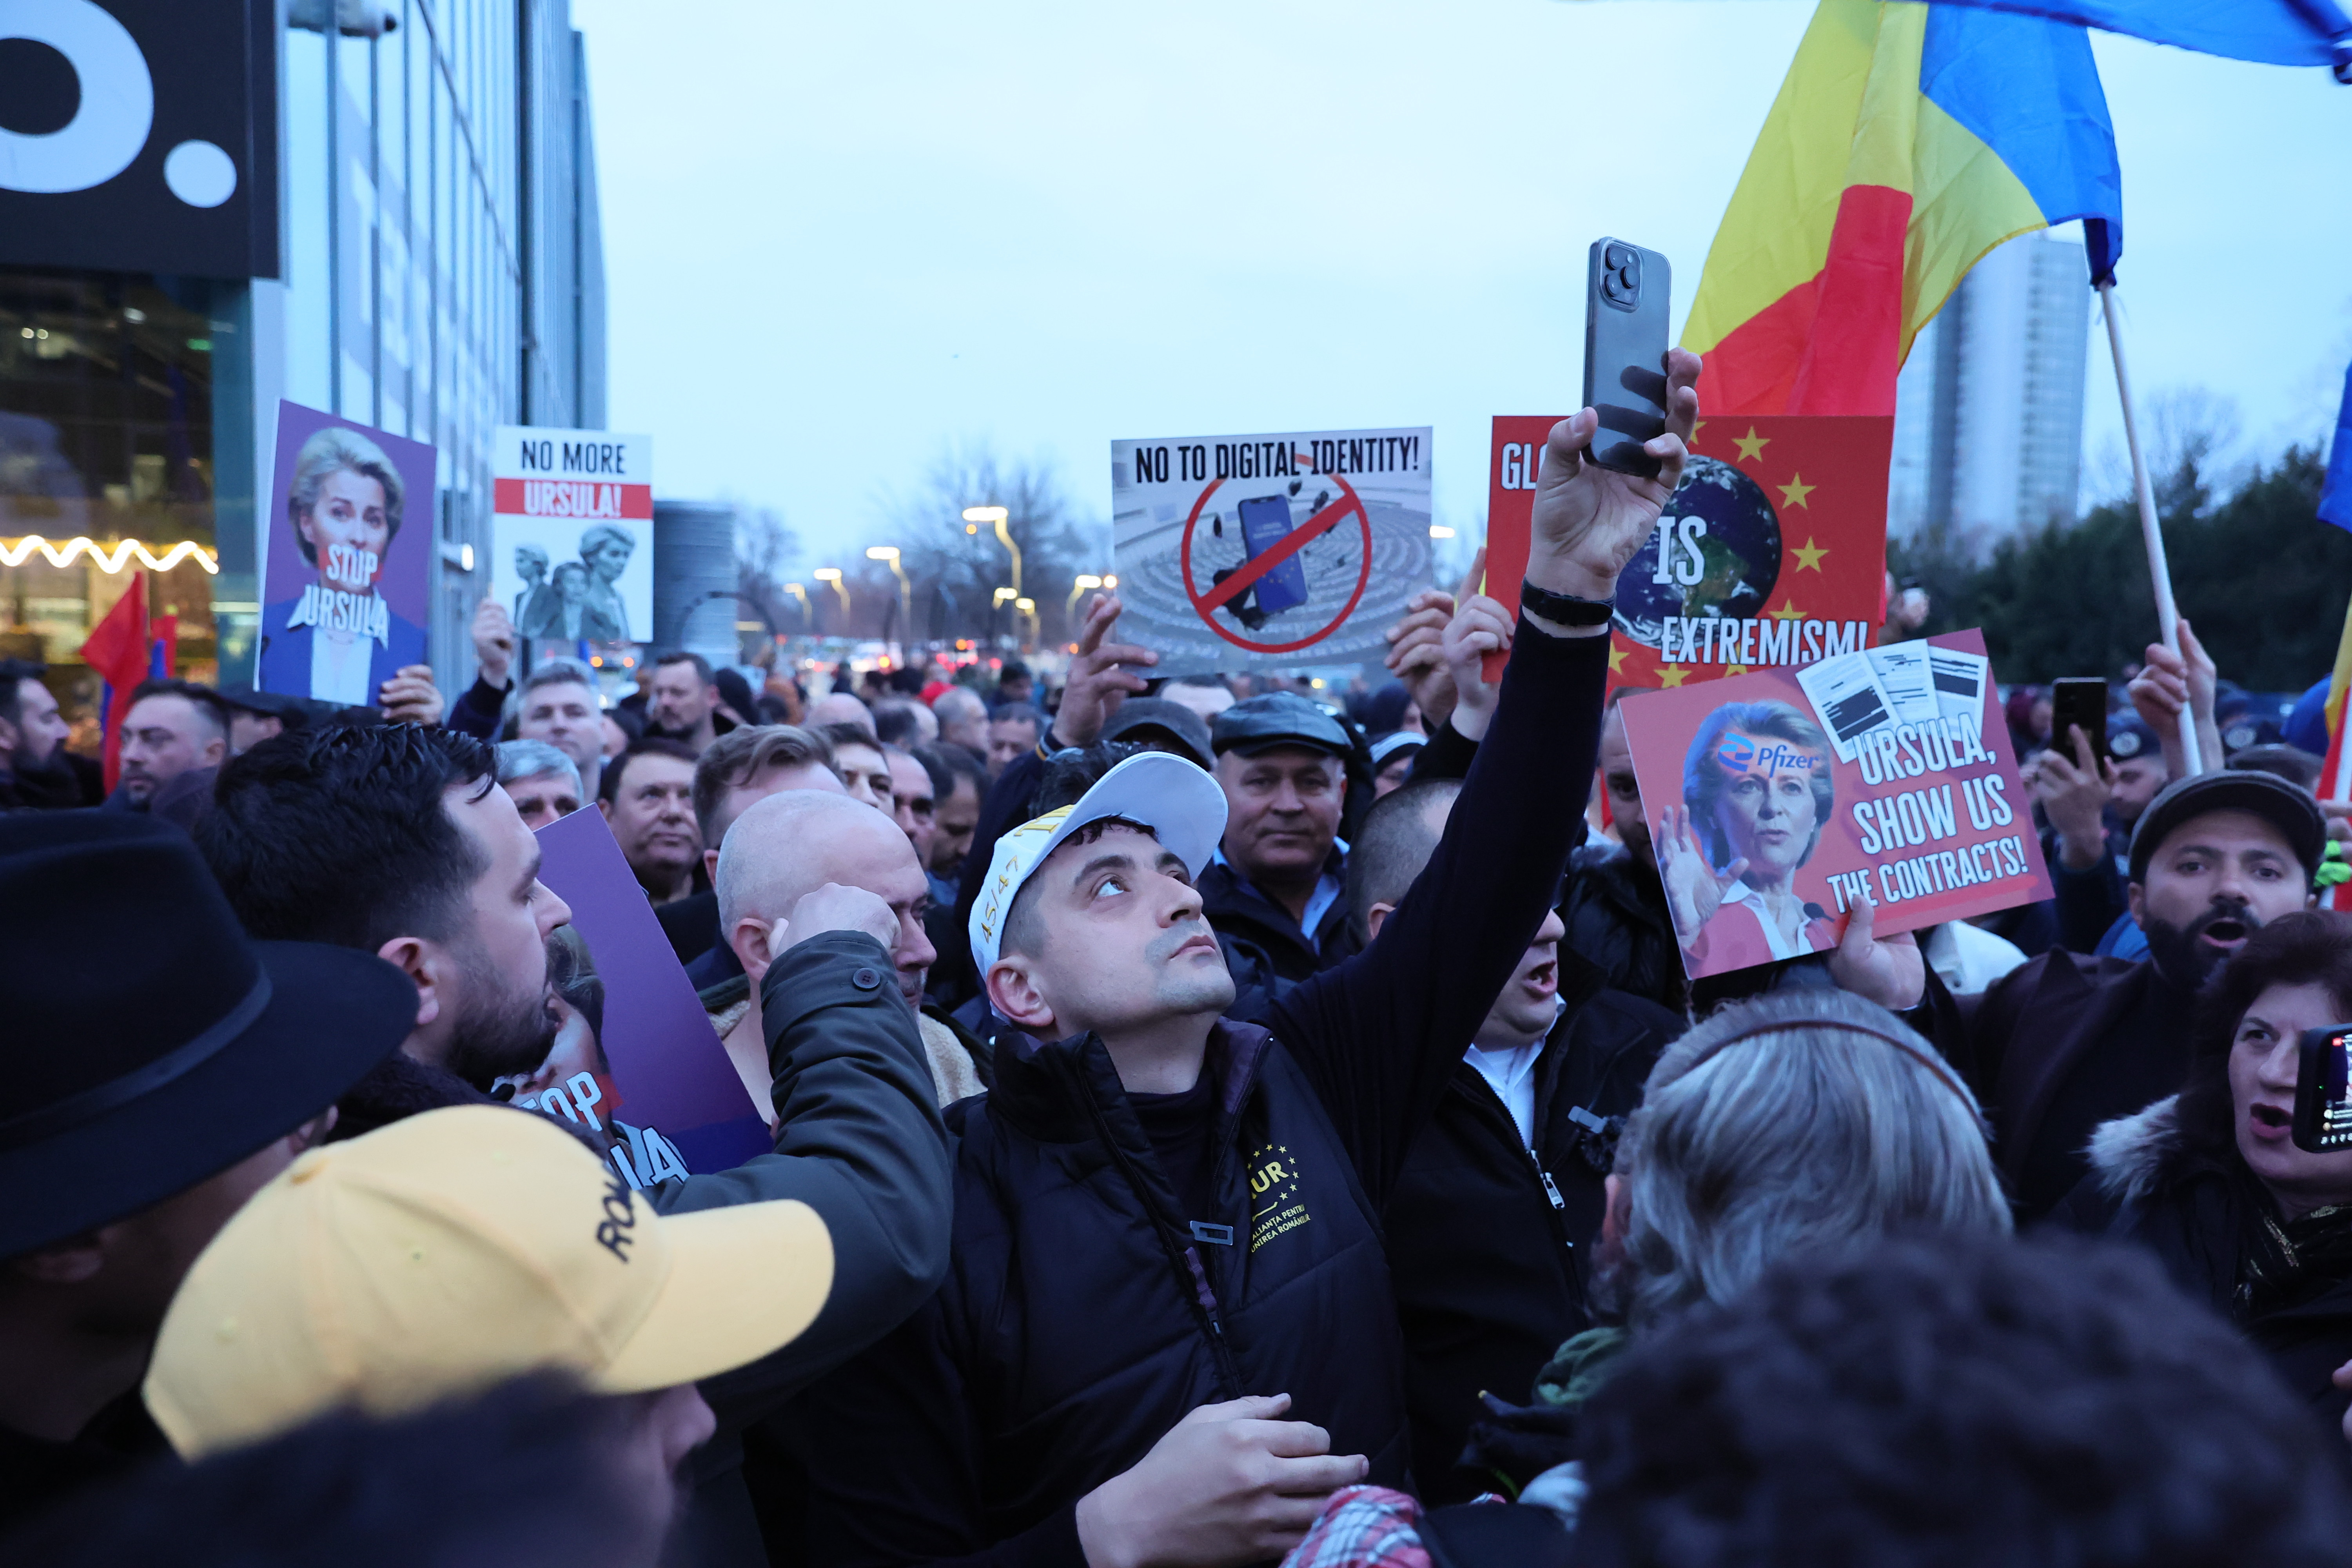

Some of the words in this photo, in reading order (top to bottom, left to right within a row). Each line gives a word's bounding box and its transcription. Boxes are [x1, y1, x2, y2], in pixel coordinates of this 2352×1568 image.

[522, 440, 552, 471] NO
[563, 442, 625, 474] MORE
[1136, 446, 1169, 483] NO
[1178, 445, 1205, 481] TO
[1216, 441, 1301, 479] DIGITAL
[1310, 436, 1419, 475] IDENTITY!
[524, 480, 622, 517] URSULA!
[326, 543, 379, 588] STOP
[1652, 515, 1707, 586] IS
[303, 584, 388, 638] URSULA
[1661, 616, 1868, 666] EXTREMISM!
[1757, 744, 1820, 779] Pfizer
[1852, 712, 1997, 785] URSULA,
[1852, 784, 1957, 855] SHOW
[1965, 773, 2013, 831] US
[1826, 868, 1880, 914] THE
[1880, 835, 2029, 904] CONTRACTS!
[1281, 1204, 1305, 1220] PENTRU
[1251, 1230, 1278, 1253] UNIREA
